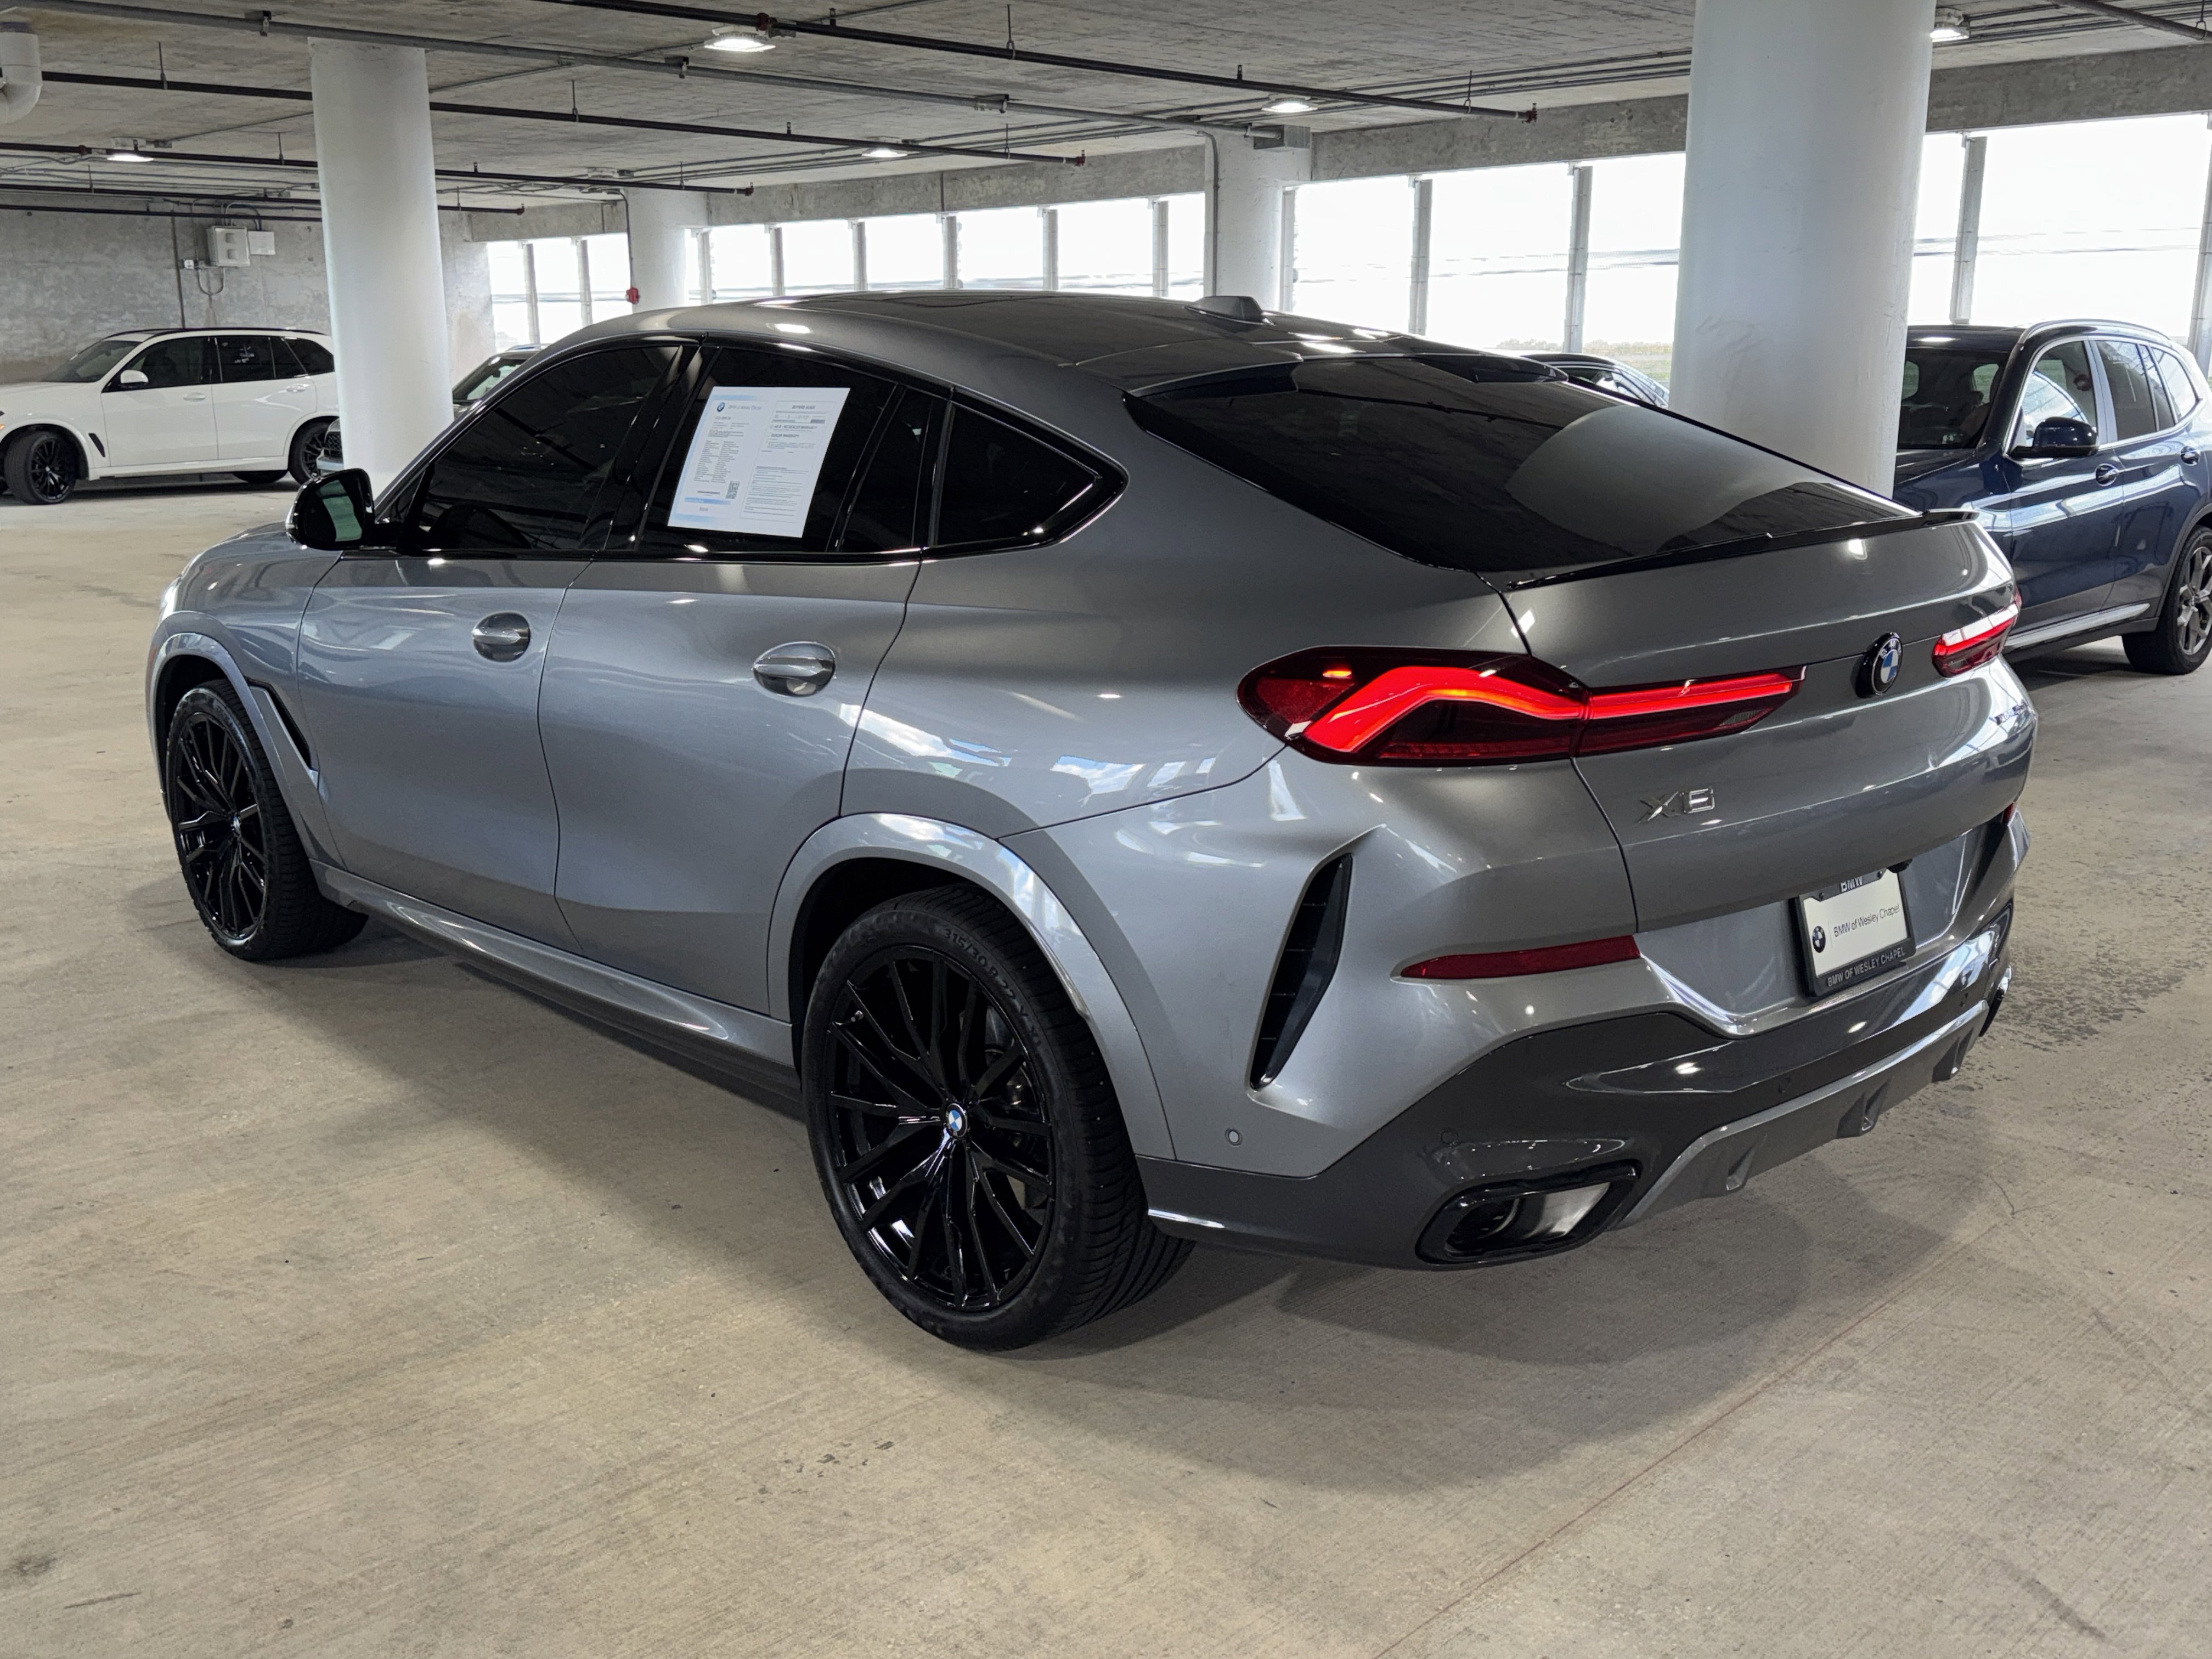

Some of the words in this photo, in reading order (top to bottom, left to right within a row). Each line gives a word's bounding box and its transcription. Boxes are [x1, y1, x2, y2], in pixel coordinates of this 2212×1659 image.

[1841, 876, 1863, 892] BMW
[1833, 922, 1850, 938] BMW
[1852, 919, 1858, 930] of
[1857, 913, 1879, 928] Wesley
[1879, 903, 1900, 919] Chapel
[943, 928, 988, 967] 315/30
[988, 966, 999, 978] R
[1827, 973, 1843, 987] BMW
[1844, 968, 1854, 980] OF
[1854, 958, 1881, 976] WESLEY
[1881, 947, 1906, 965] CHAPEL
